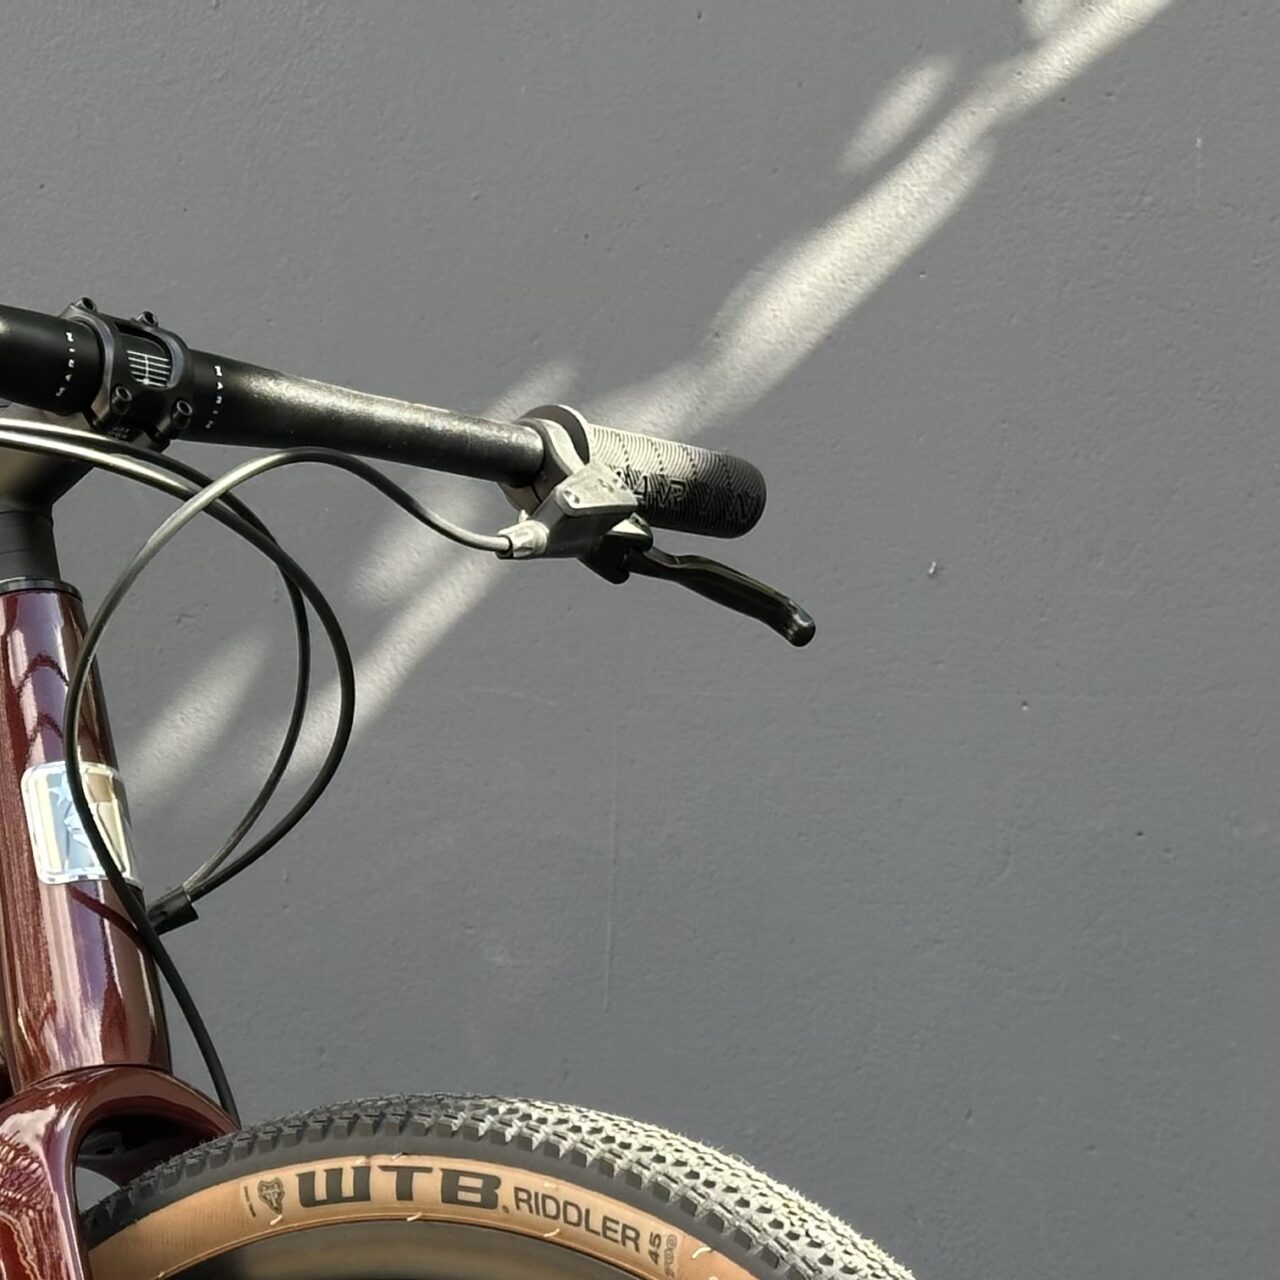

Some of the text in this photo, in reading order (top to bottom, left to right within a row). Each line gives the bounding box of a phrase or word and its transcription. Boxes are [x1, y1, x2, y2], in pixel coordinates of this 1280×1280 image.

[296, 1164, 503, 1210] WTB
[514, 1186, 641, 1254] RIDDLER
[647, 1231, 662, 1266] 45
